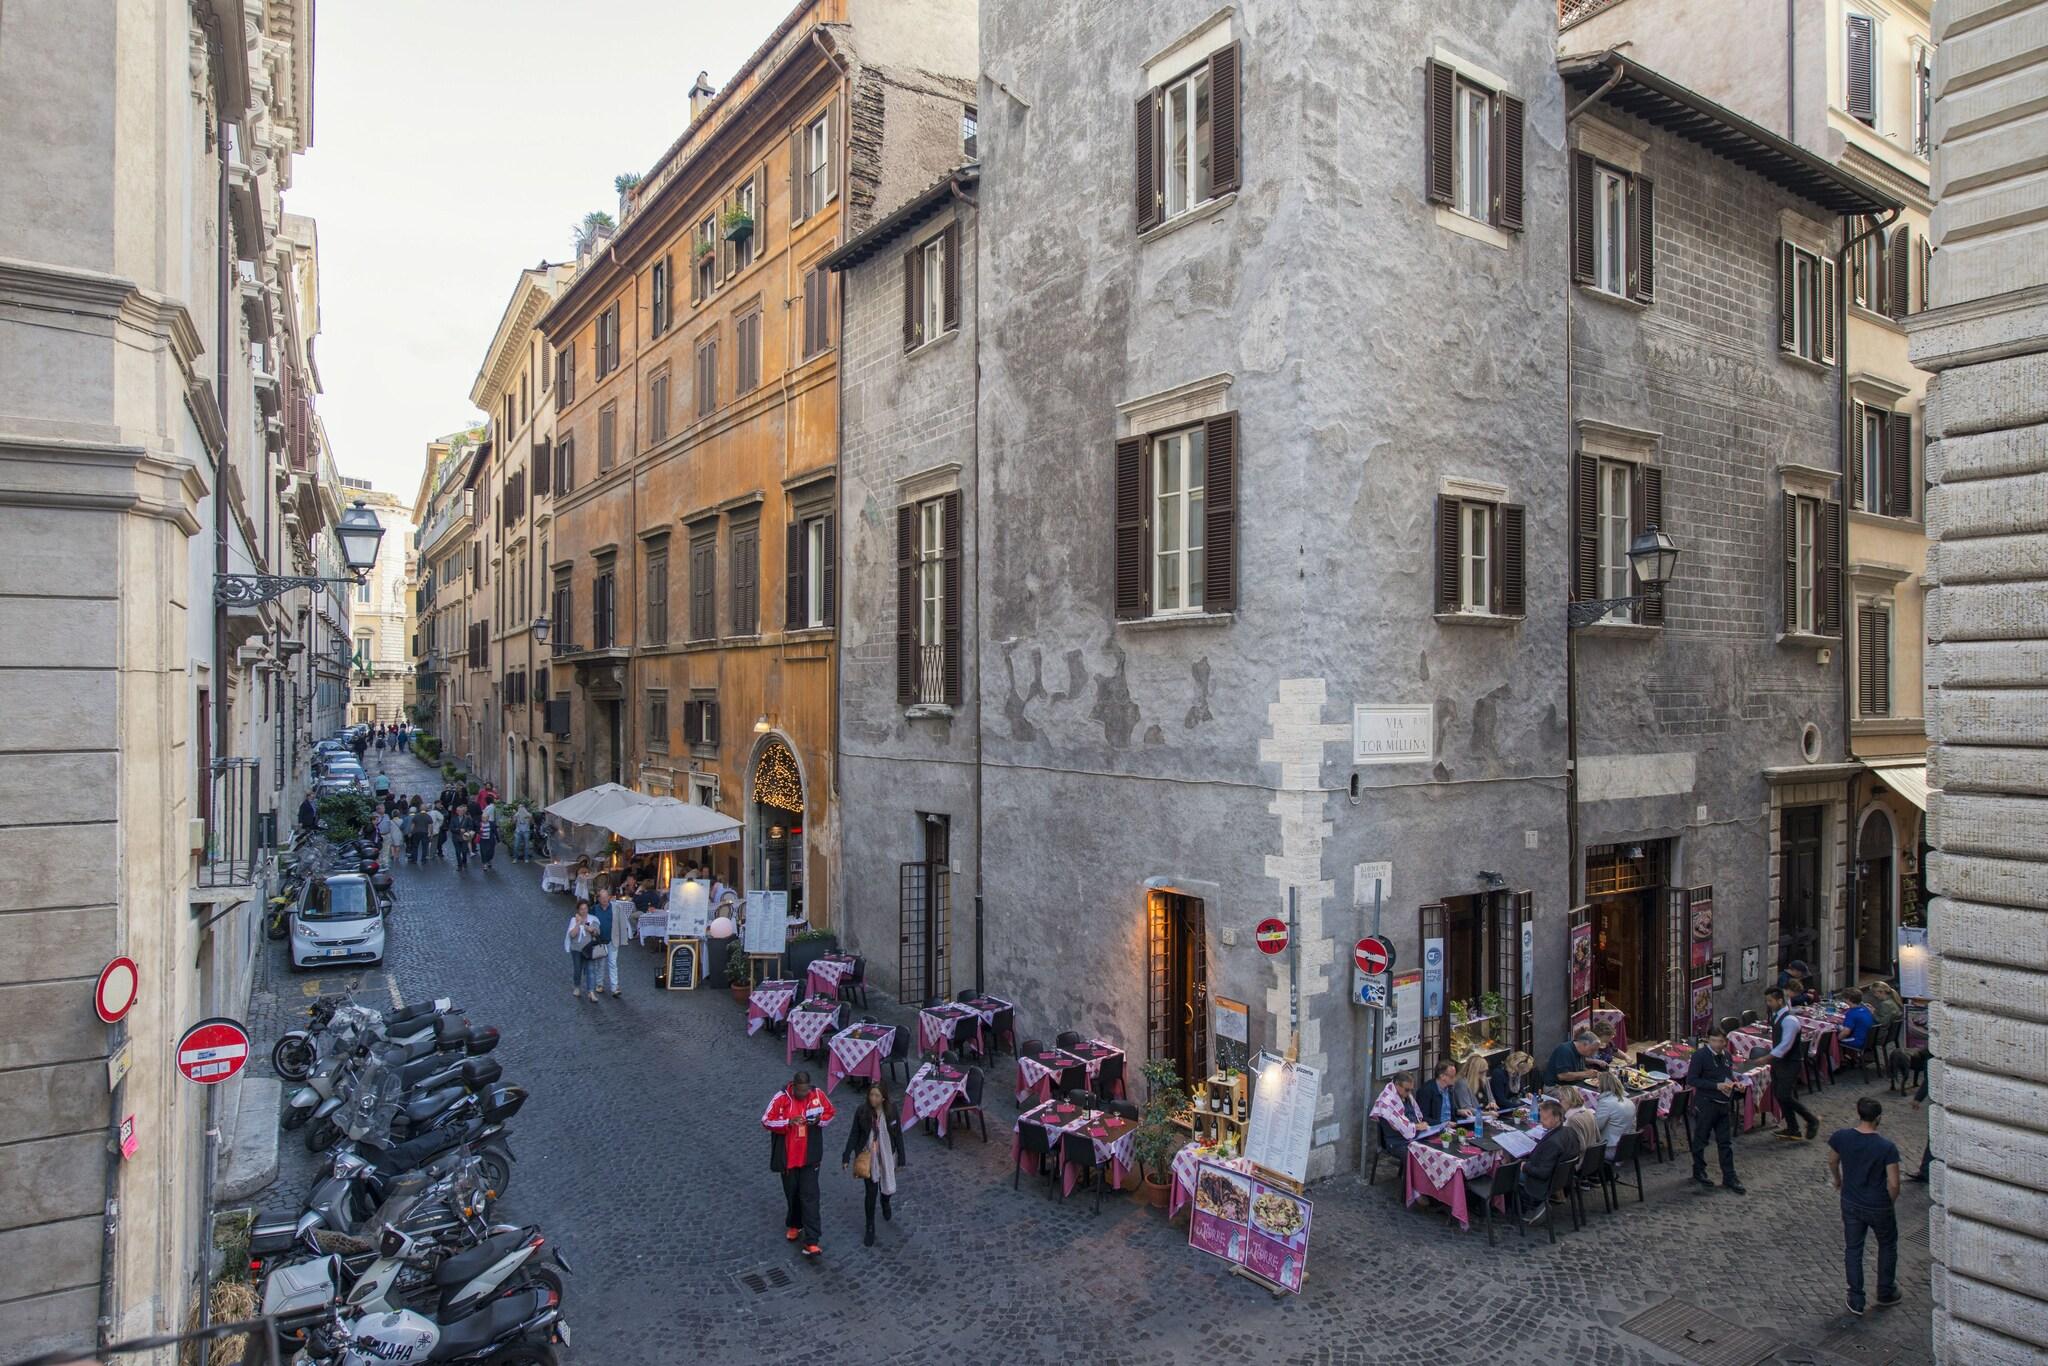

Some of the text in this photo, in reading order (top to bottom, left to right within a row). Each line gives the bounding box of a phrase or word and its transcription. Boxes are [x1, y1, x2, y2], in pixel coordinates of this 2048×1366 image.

[1386, 717, 1403, 728] VIA
[1360, 739, 1426, 752] TOR MILLINA
